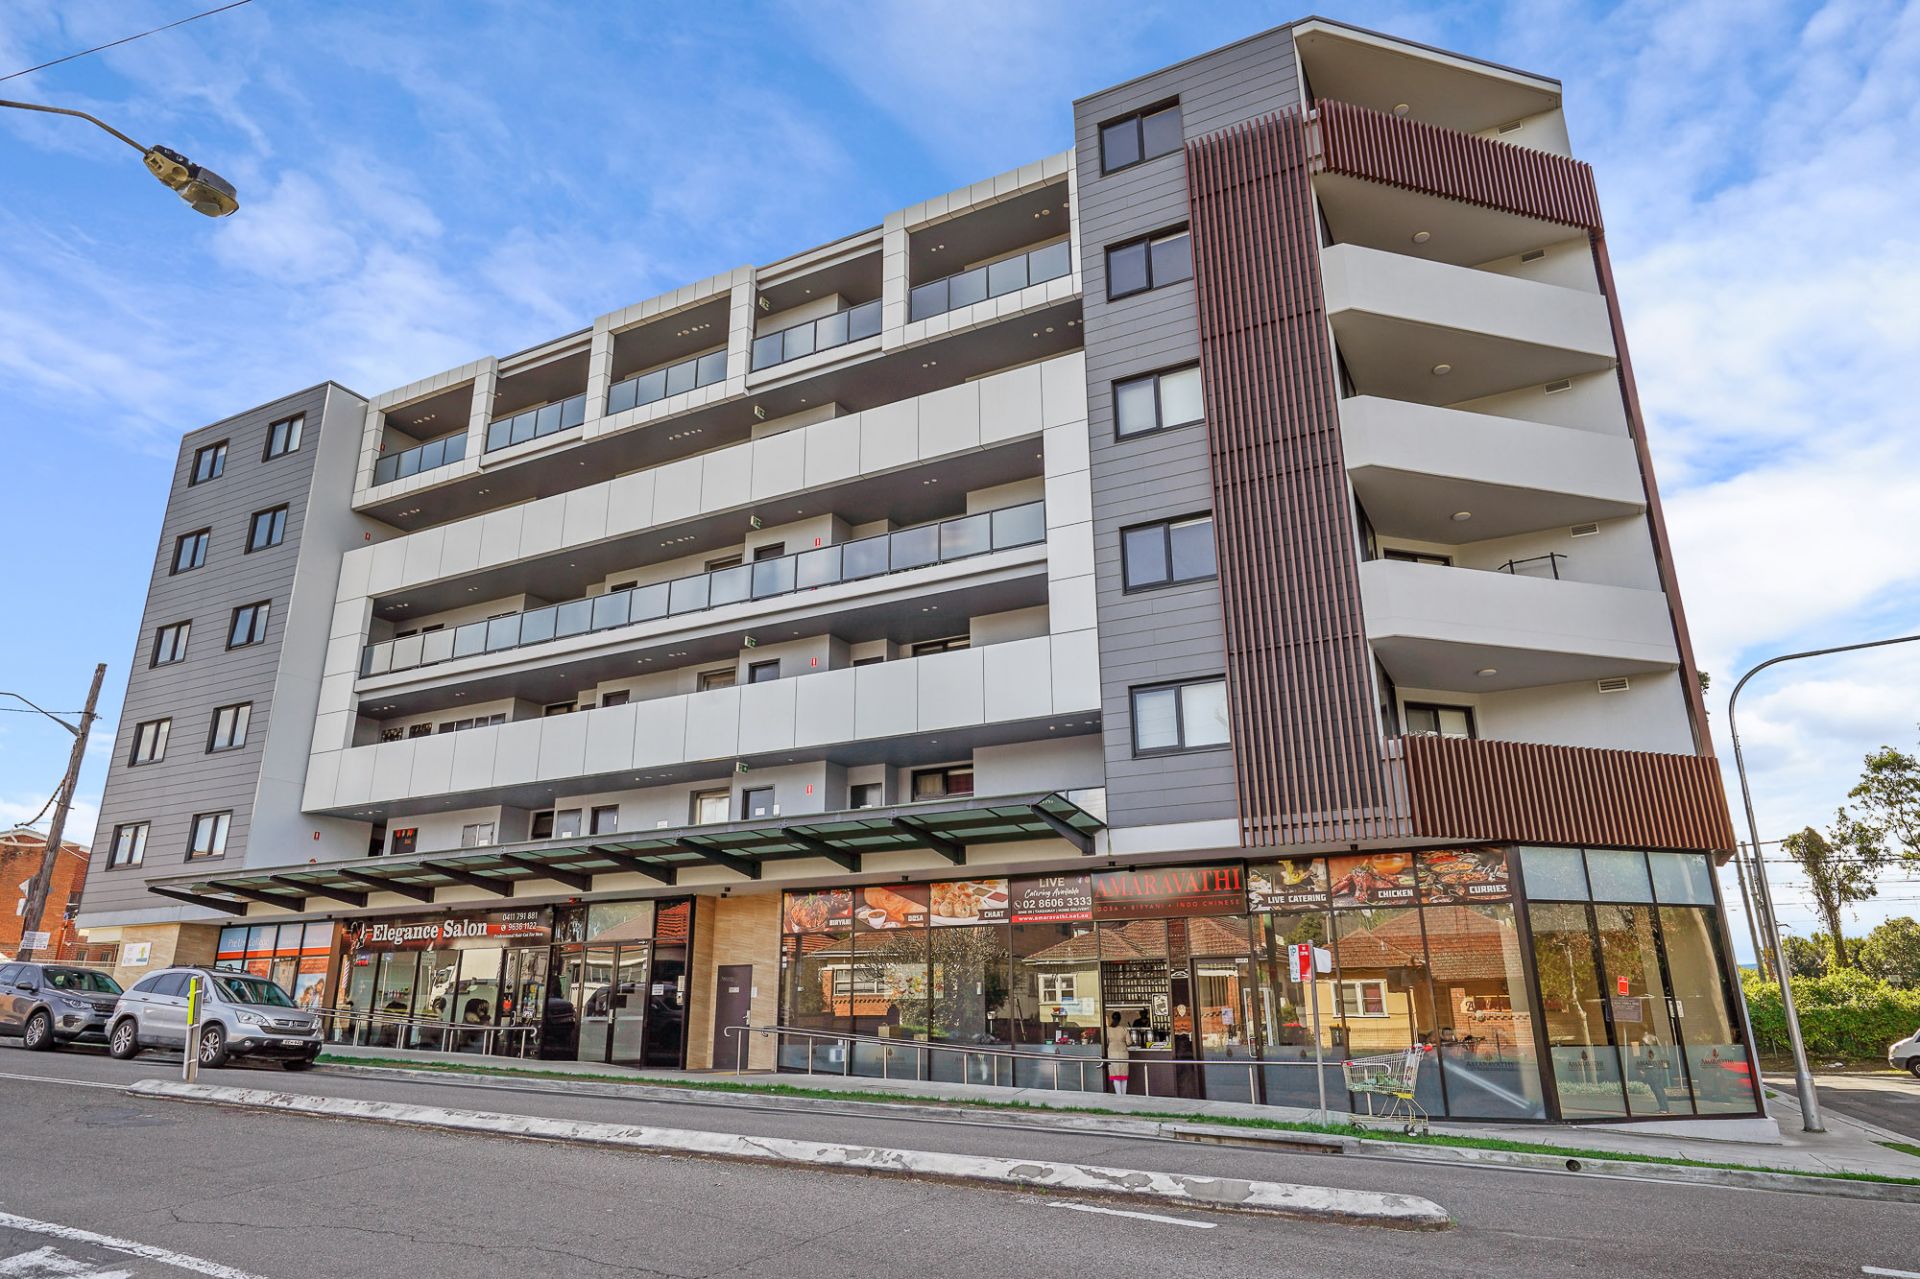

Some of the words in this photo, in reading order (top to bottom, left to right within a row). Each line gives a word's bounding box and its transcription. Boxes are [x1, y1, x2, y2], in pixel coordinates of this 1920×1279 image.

[1039, 877, 1065, 888] LIVE
[1094, 868, 1241, 897] AMARAVATHI
[1024, 889, 1051, 899] Catering
[1378, 889, 1414, 898] CHICKEN
[1469, 884, 1507, 894] CURRIES
[1023, 900, 1036, 909] 02
[1038, 898, 1064, 908] 8606
[1066, 896, 1092, 907] 3333
[1203, 899, 1240, 907] CHINESE
[1267, 895, 1285, 904] LIVE
[1288, 893, 1327, 903] CATERING
[502, 912, 516, 921] 0411
[516, 912, 526, 920] 791
[527, 911, 538, 920] 881
[907, 914, 924, 922] DOSA
[984, 910, 1004, 918] CHAAT
[371, 924, 439, 945] Elegance
[442, 919, 487, 938] Salon
